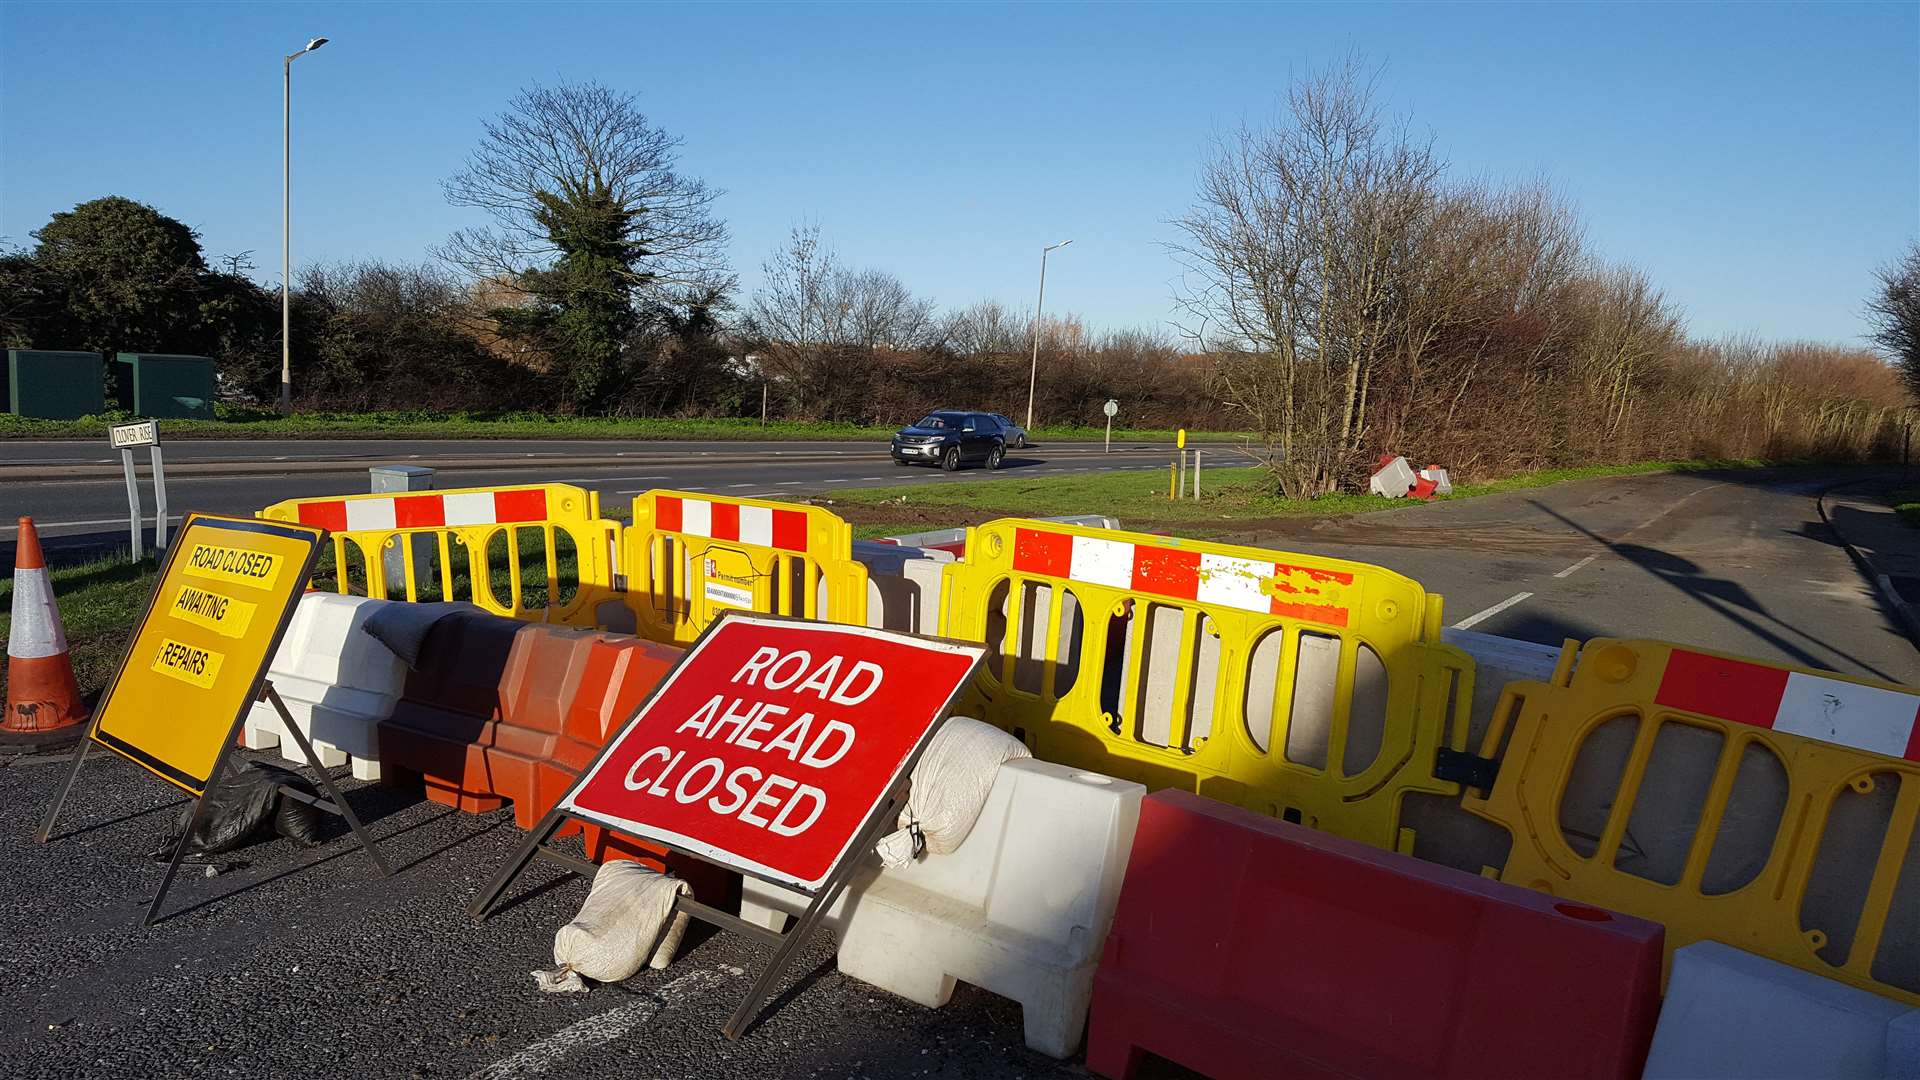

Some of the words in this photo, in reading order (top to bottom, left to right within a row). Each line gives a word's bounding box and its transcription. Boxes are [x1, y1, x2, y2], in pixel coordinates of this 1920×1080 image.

[116, 428, 138, 443] CLOVER
[139, 426, 152, 441] RISE
[190, 546, 224, 570] ROAD
[222, 550, 273, 578] CLOSED
[175, 588, 229, 621] AWAITING
[161, 642, 209, 675] REPAIRS
[731, 646, 884, 706] ROAD
[675, 695, 856, 769] AHEAD
[624, 745, 827, 837] CLOSED
